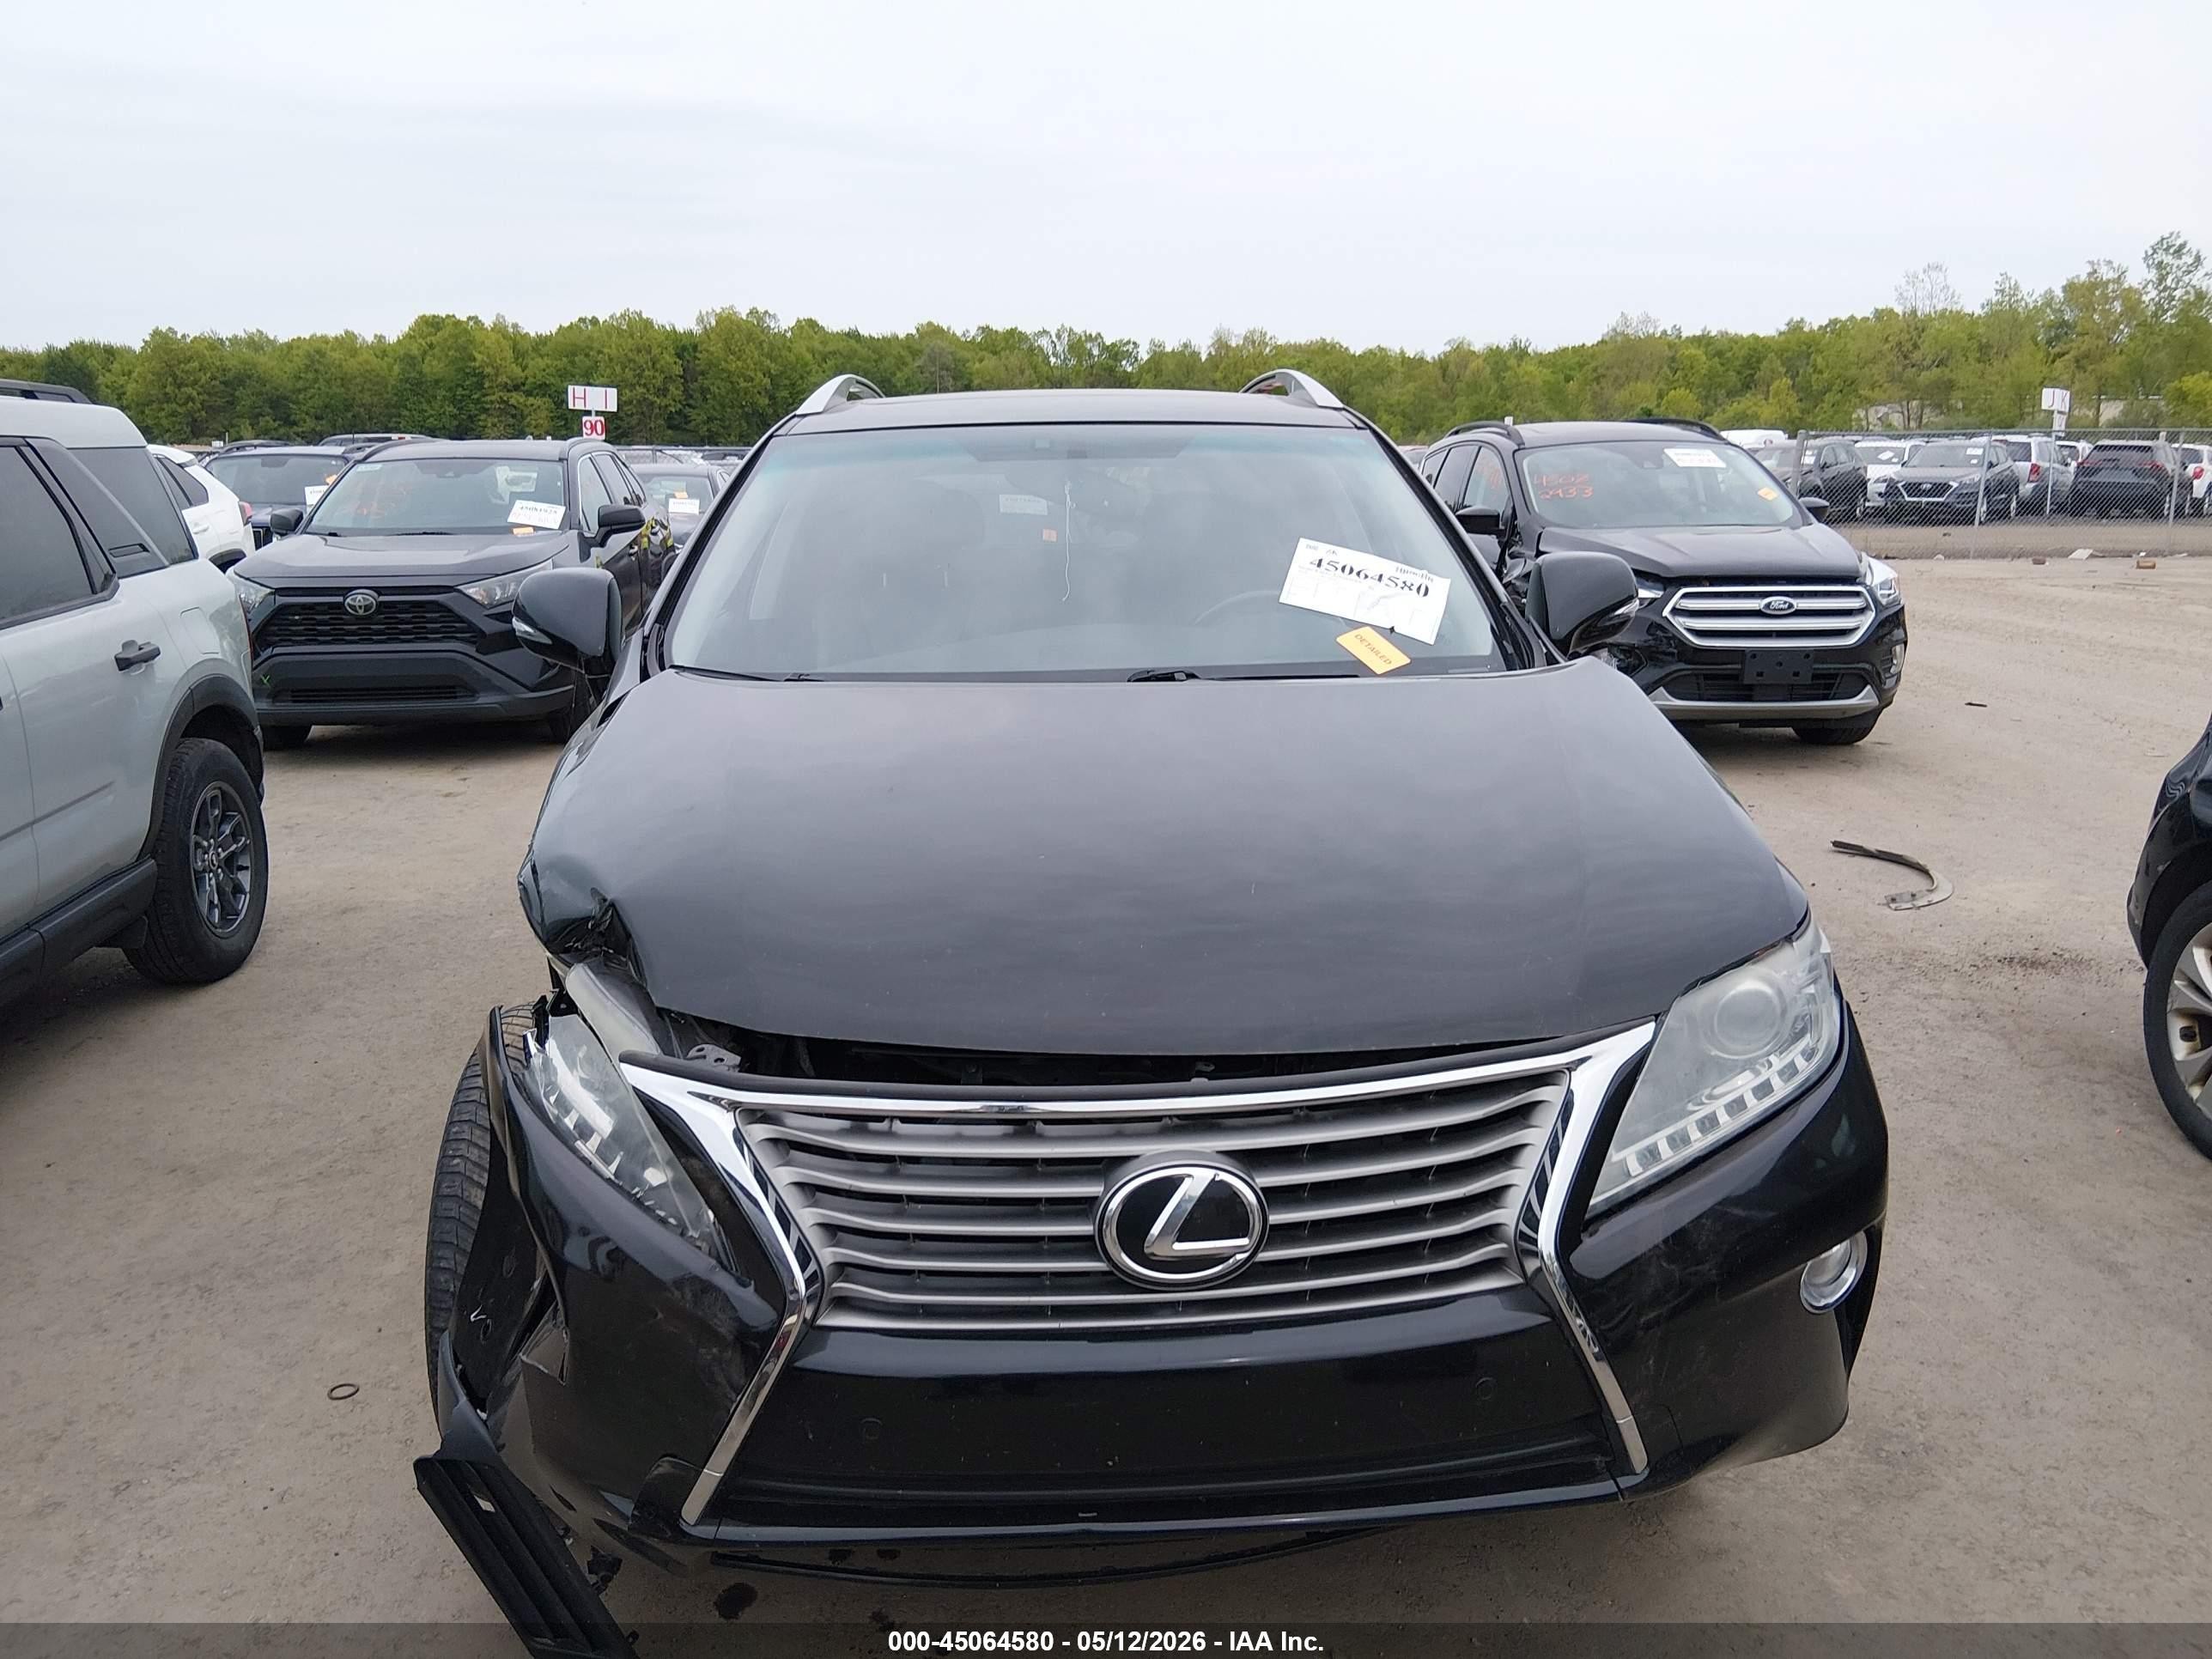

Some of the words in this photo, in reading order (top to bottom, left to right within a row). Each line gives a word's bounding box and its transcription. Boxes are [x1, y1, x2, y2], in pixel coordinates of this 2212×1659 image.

[572, 387, 586, 409] H
[2048, 390, 2055, 409] J
[583, 419, 605, 436] 90
[1309, 558, 1430, 598] 45064580
[1354, 633, 1393, 666] DETAILED
